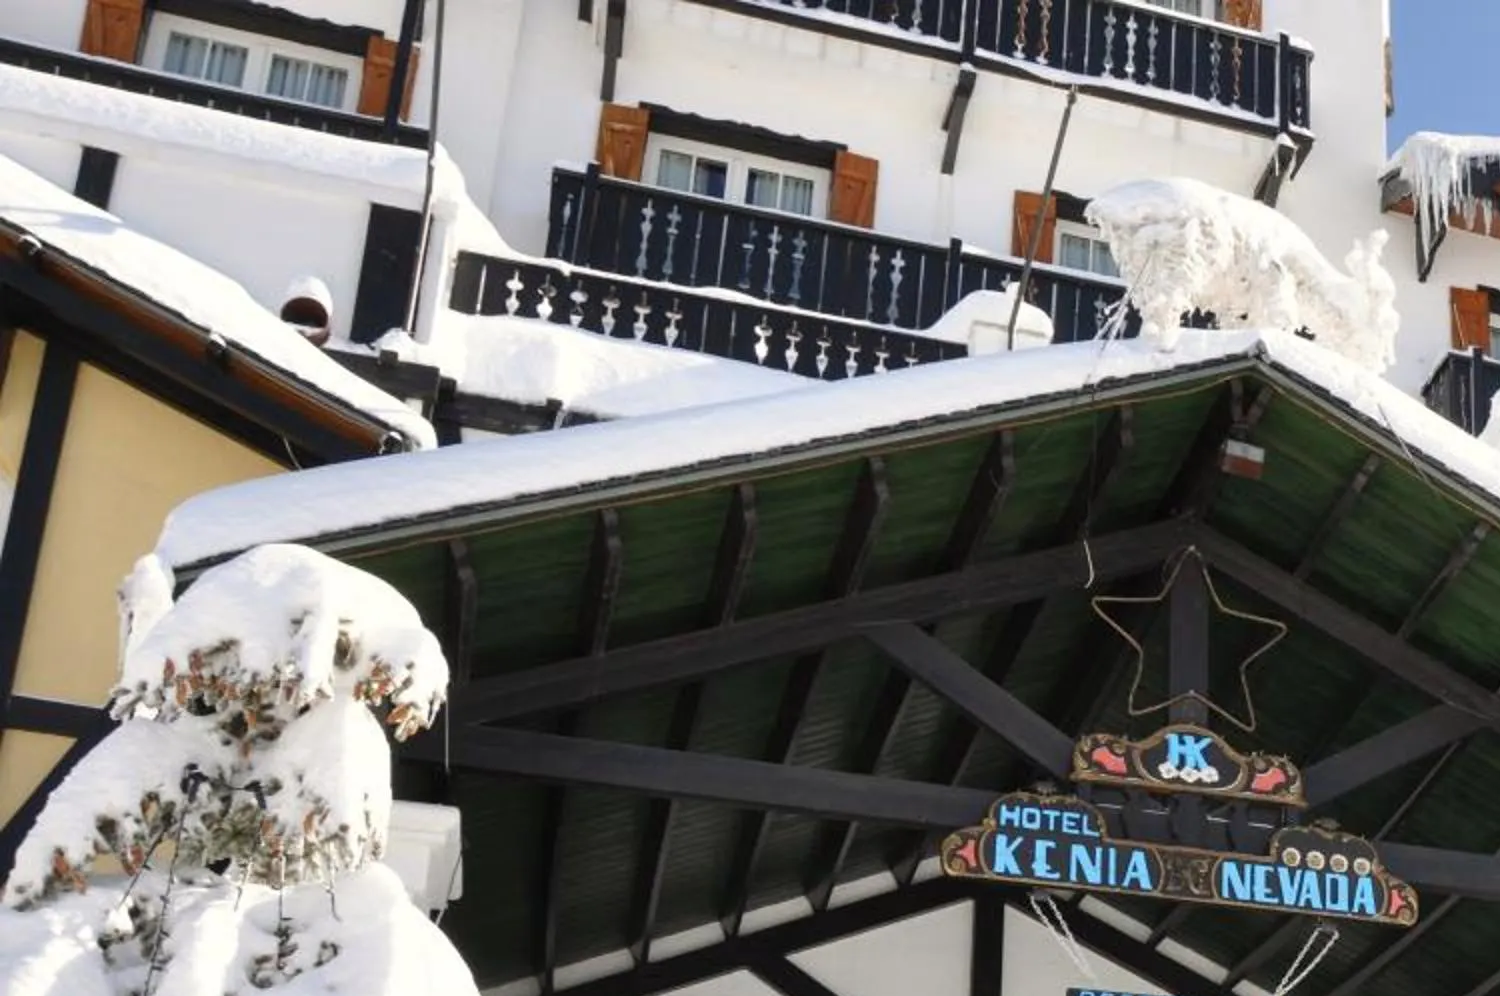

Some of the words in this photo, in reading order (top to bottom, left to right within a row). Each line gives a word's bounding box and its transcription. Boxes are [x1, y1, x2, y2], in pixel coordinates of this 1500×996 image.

[1000, 804, 1100, 838] HOTEL
[993, 833, 1154, 891] KENIA
[1221, 860, 1377, 915] NEVADA
